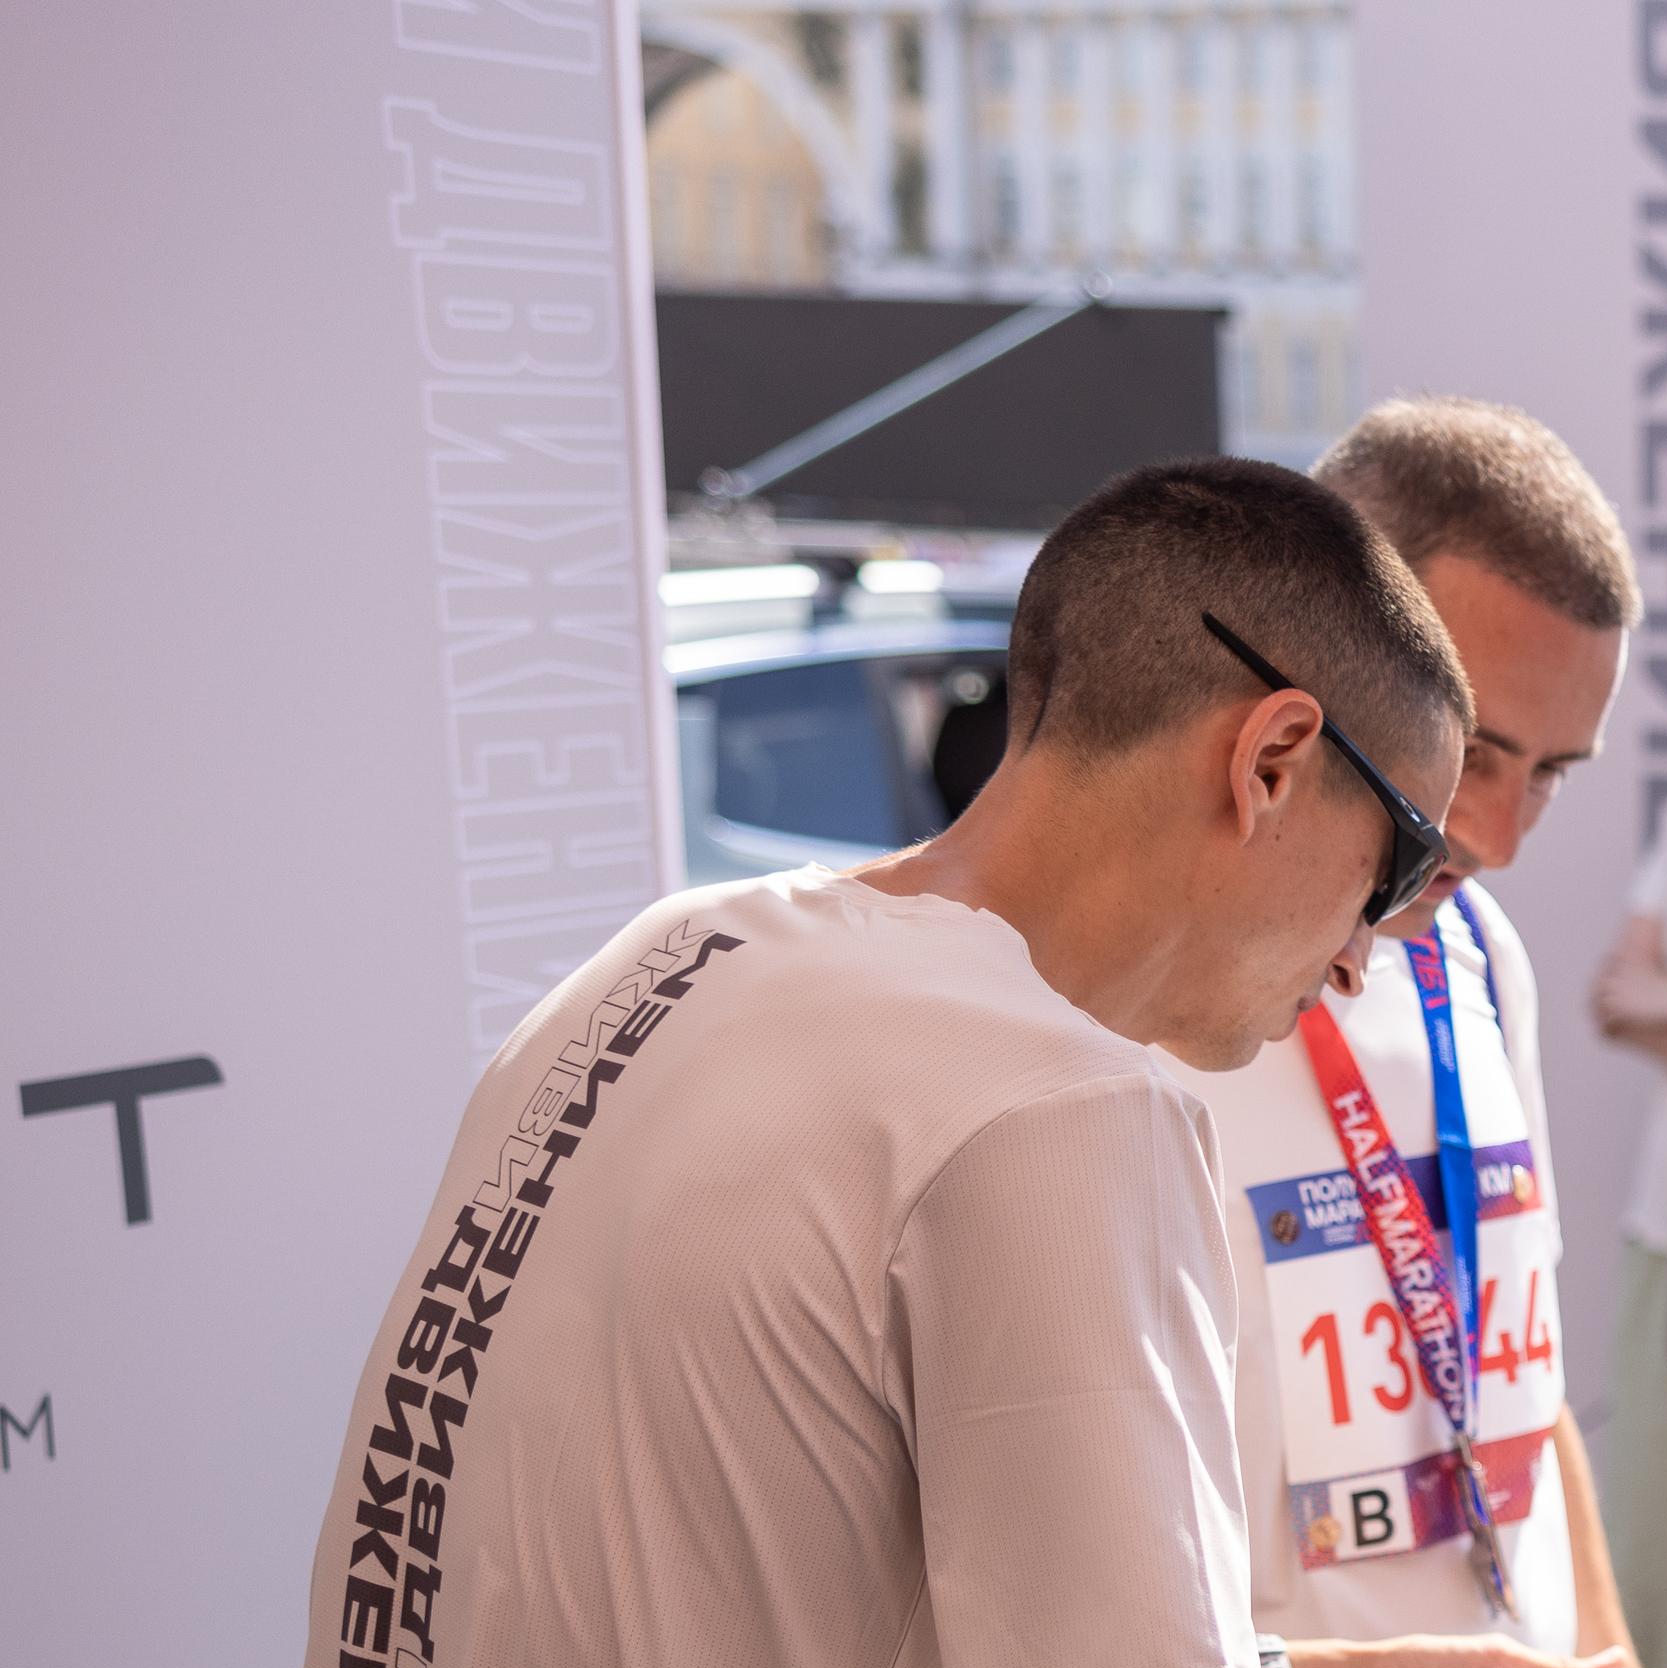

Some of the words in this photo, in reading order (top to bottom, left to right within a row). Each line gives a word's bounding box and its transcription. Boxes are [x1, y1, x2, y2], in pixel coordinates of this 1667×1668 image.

[384, 96, 665, 1060] ДВИЖЕНИ
[19, 1052, 226, 1227] T
[473, 918, 717, 1214] ЖИВИ
[398, 931, 748, 1665] ДВИЖЕНИЕМ
[1300, 1269, 1553, 1428] 1344
[1351, 1488, 1395, 1548] B
